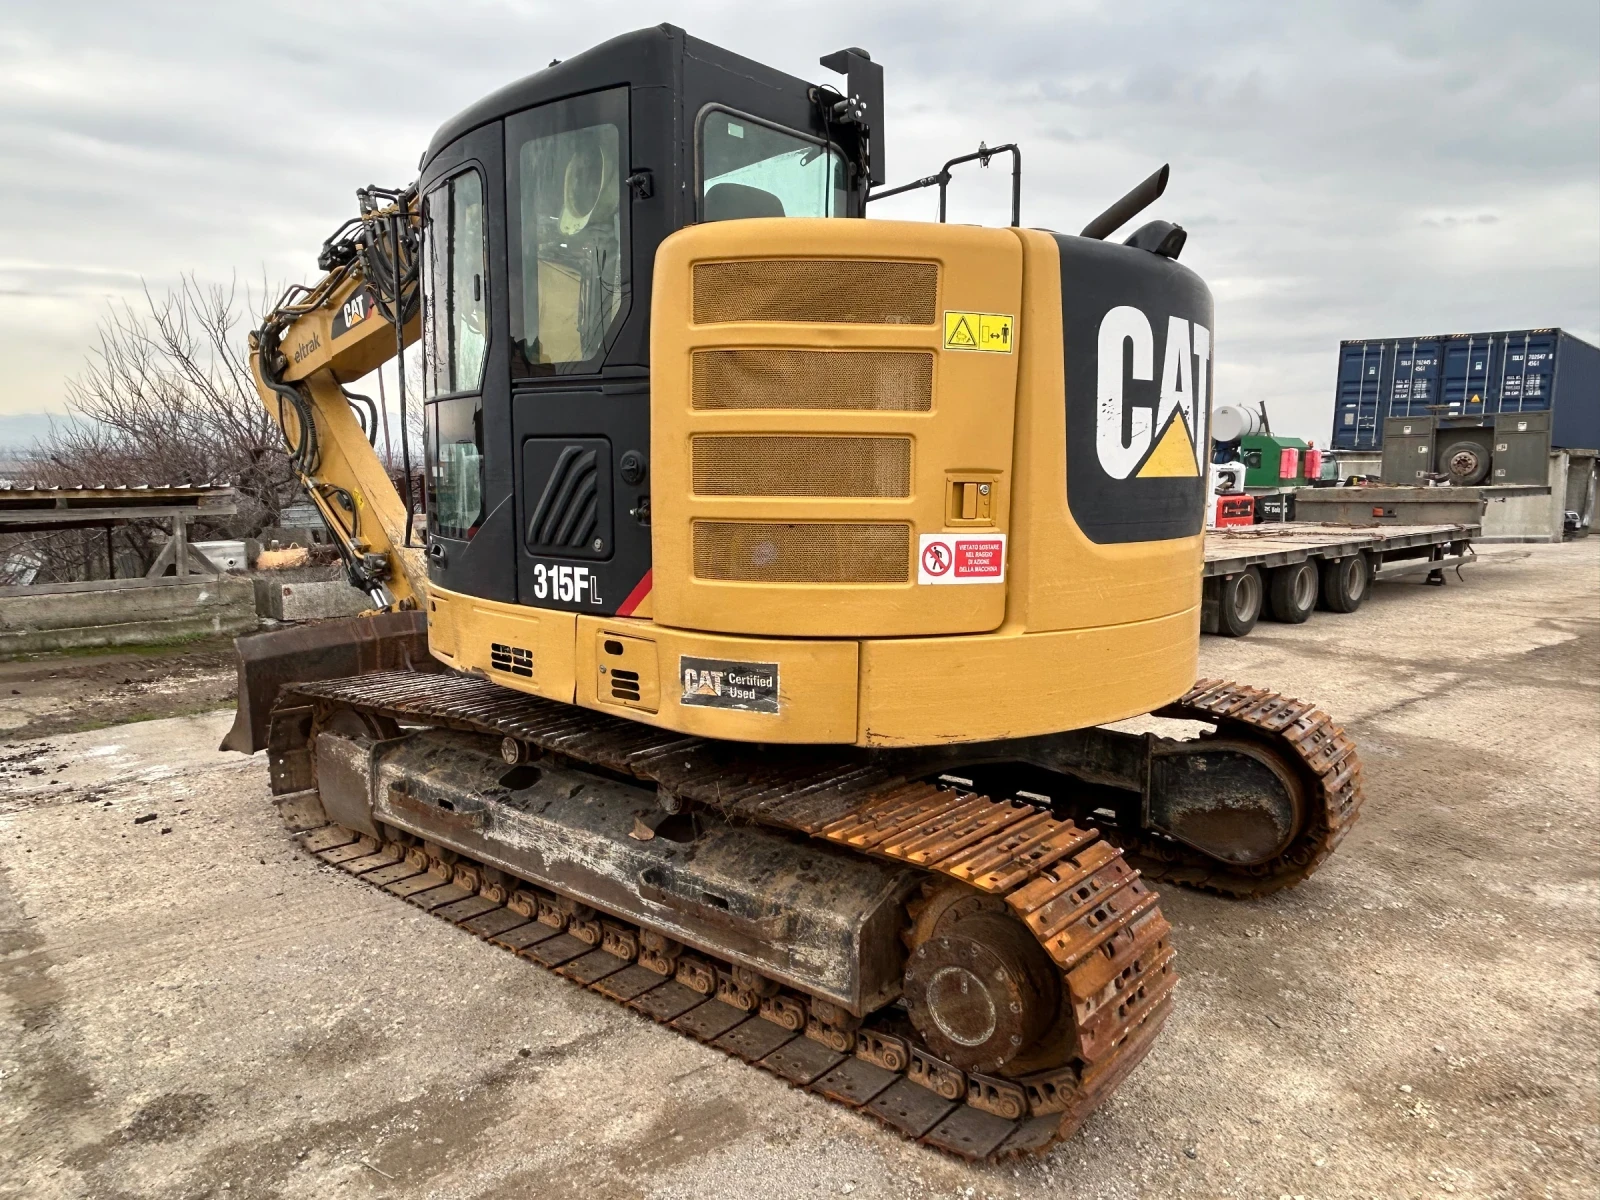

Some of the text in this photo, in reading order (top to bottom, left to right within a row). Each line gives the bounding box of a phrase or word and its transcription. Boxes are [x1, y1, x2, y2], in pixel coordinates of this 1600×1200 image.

[343, 294, 365, 328] CAT
[293, 331, 321, 364] eltrak
[1096, 305, 1210, 480] CAT
[684, 668, 773, 697] CAT Certified
[729, 686, 756, 700] Used
